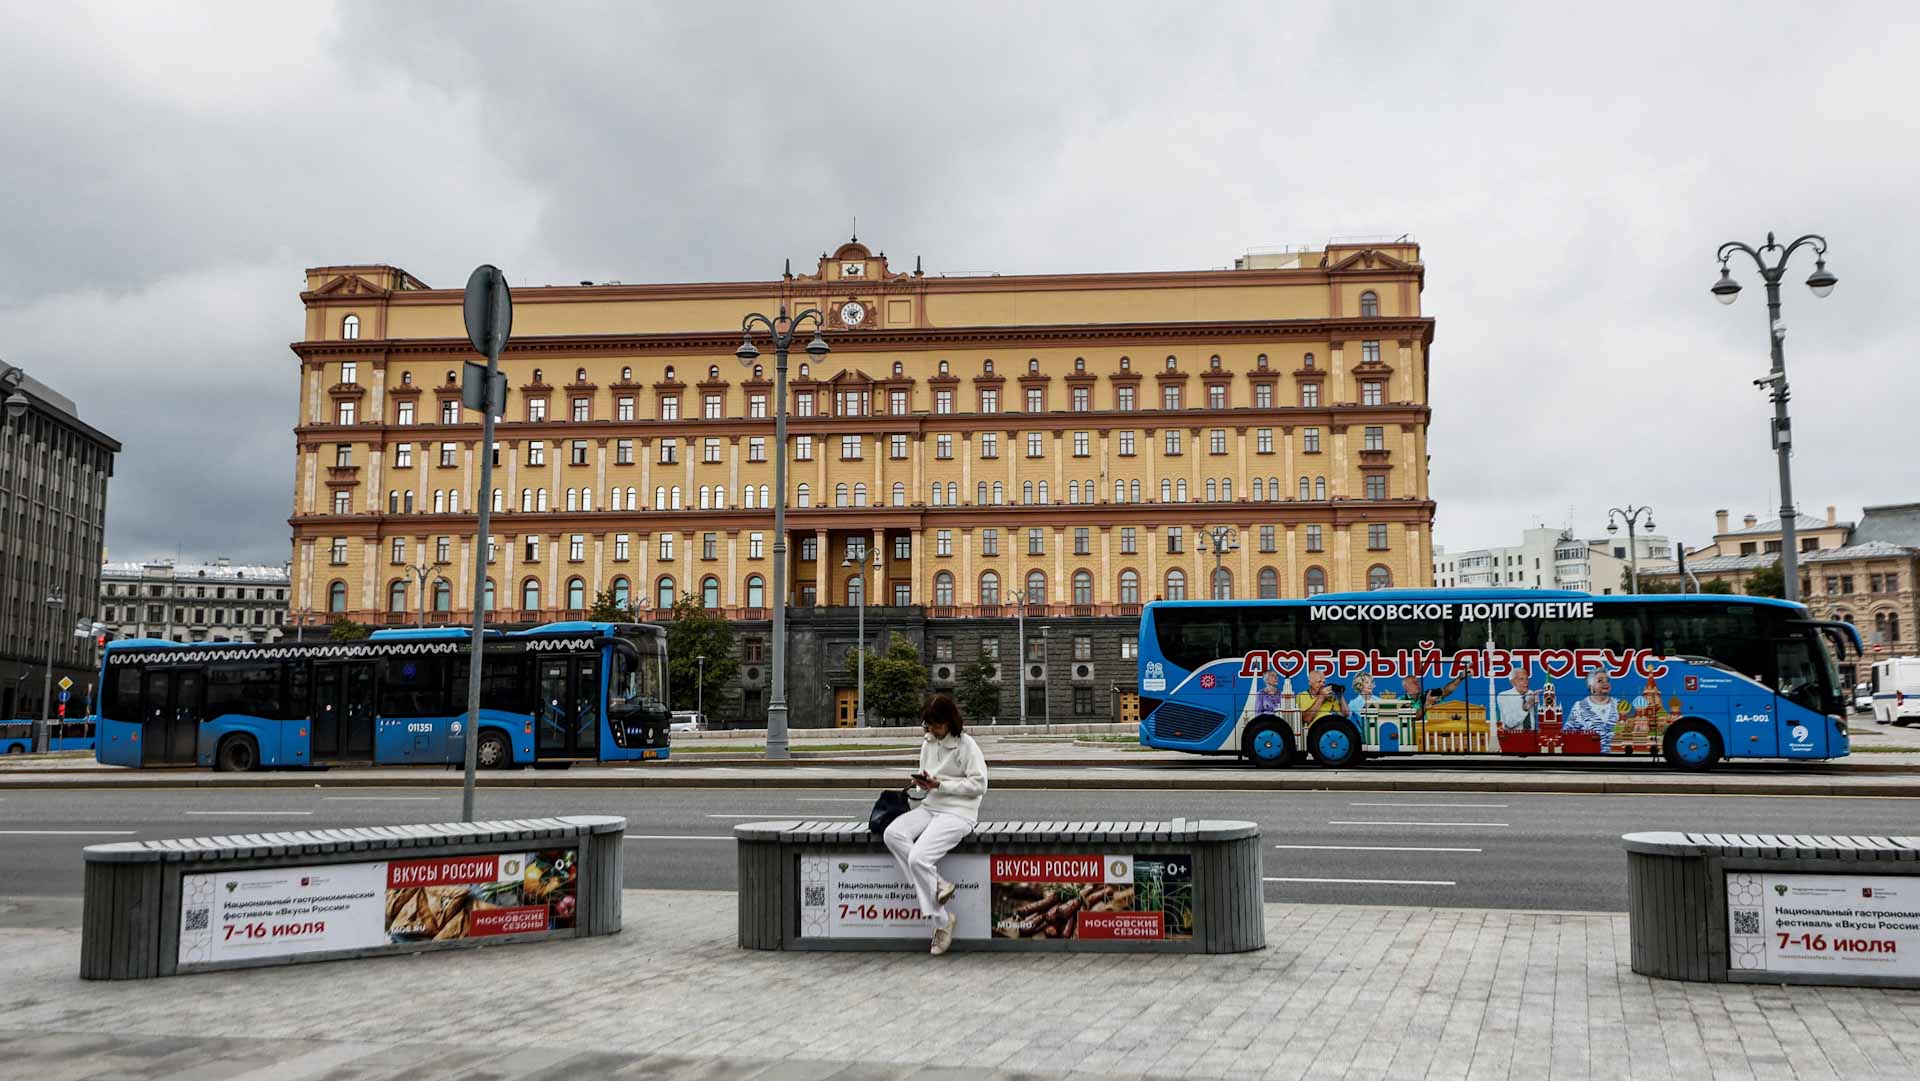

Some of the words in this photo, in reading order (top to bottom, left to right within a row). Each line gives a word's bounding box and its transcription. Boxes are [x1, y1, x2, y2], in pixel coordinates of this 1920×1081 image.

[1310, 604, 1453, 620] МОСКОВСКОЕ
[1459, 602, 1594, 621] ДОЛГОЛЕТИЕ
[1735, 714, 1770, 723] ДА-001
[407, 723, 433, 733] 011351
[393, 865, 438, 884] ВКУСЫ
[442, 861, 493, 880] РОССИИ
[996, 860, 1041, 877] ВКУСЫ
[1045, 860, 1099, 877] РОССИИ
[1167, 863, 1187, 875] 0+
[838, 880, 899, 890] Национальный
[223, 896, 292, 910] Национальный
[293, 890, 376, 904] гастрономический
[838, 892, 883, 900] фестиваль
[223, 910, 273, 921] фестиваль
[1775, 906, 1853, 917] Национальный
[476, 912, 545, 926] МОСКОВСКИЕ
[1085, 919, 1159, 928] МОСКОВСКИЕ
[1775, 918, 1833, 928] фестиваль
[1835, 919, 1876, 930] «Вкусы
[271, 921, 326, 937] июля
[502, 920, 544, 932] СЕЗОНЫ
[1114, 927, 1159, 936] СЕЗОНЫ
[1834, 938, 1897, 953] июля
